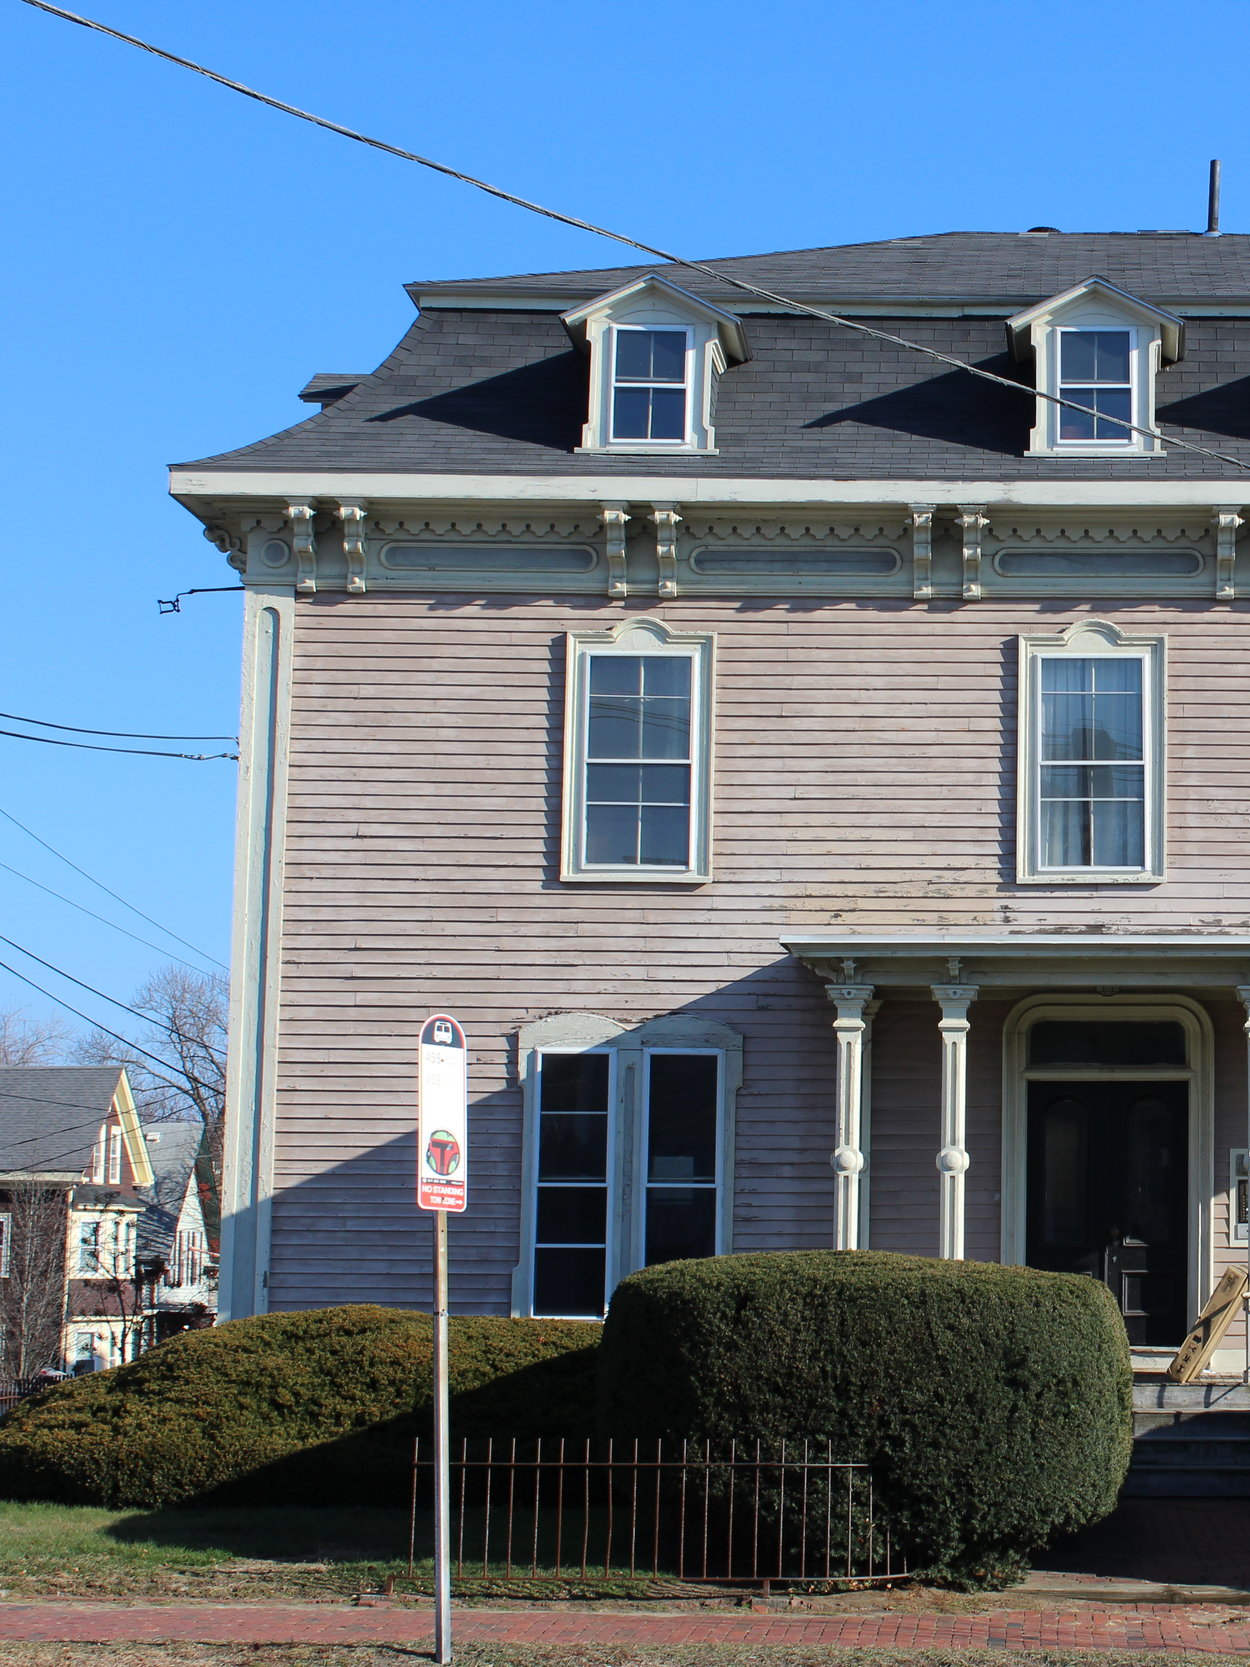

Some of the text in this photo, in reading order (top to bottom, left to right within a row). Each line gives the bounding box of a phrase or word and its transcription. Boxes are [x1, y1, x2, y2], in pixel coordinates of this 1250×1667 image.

[422, 1184, 464, 1196] NO STANDING
[430, 1196, 443, 1204] TOW
